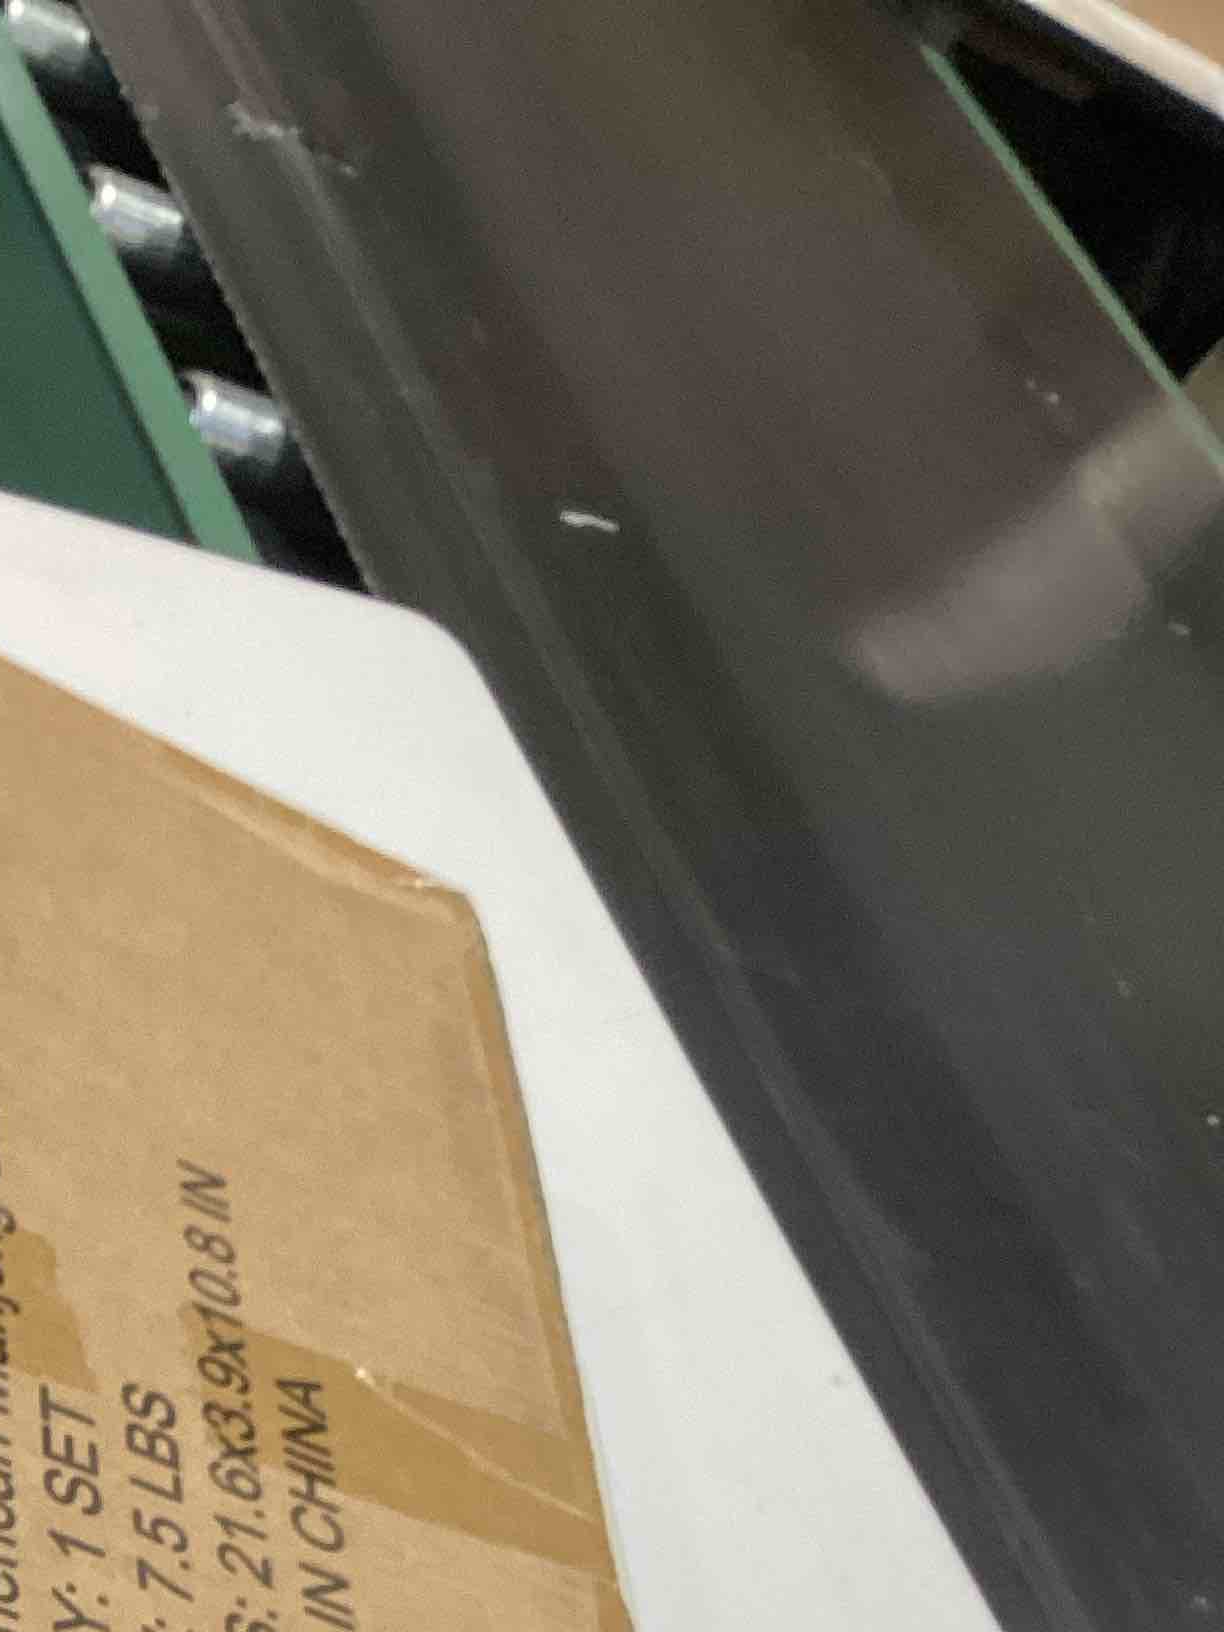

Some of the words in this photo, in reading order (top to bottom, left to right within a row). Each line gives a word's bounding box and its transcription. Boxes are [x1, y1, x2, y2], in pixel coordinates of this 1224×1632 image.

[177, 1158, 232, 1223] IN
[38, 1382, 103, 1516] SET
[121, 1382, 184, 1502] LBS
[183, 1224, 275, 1590] 21.6x3.9x10.8
[275, 1378, 346, 1555] CHINA
[48, 1528, 107, 1559] 1
[133, 1508, 195, 1602] 7.5
[298, 1560, 357, 1632] IN
